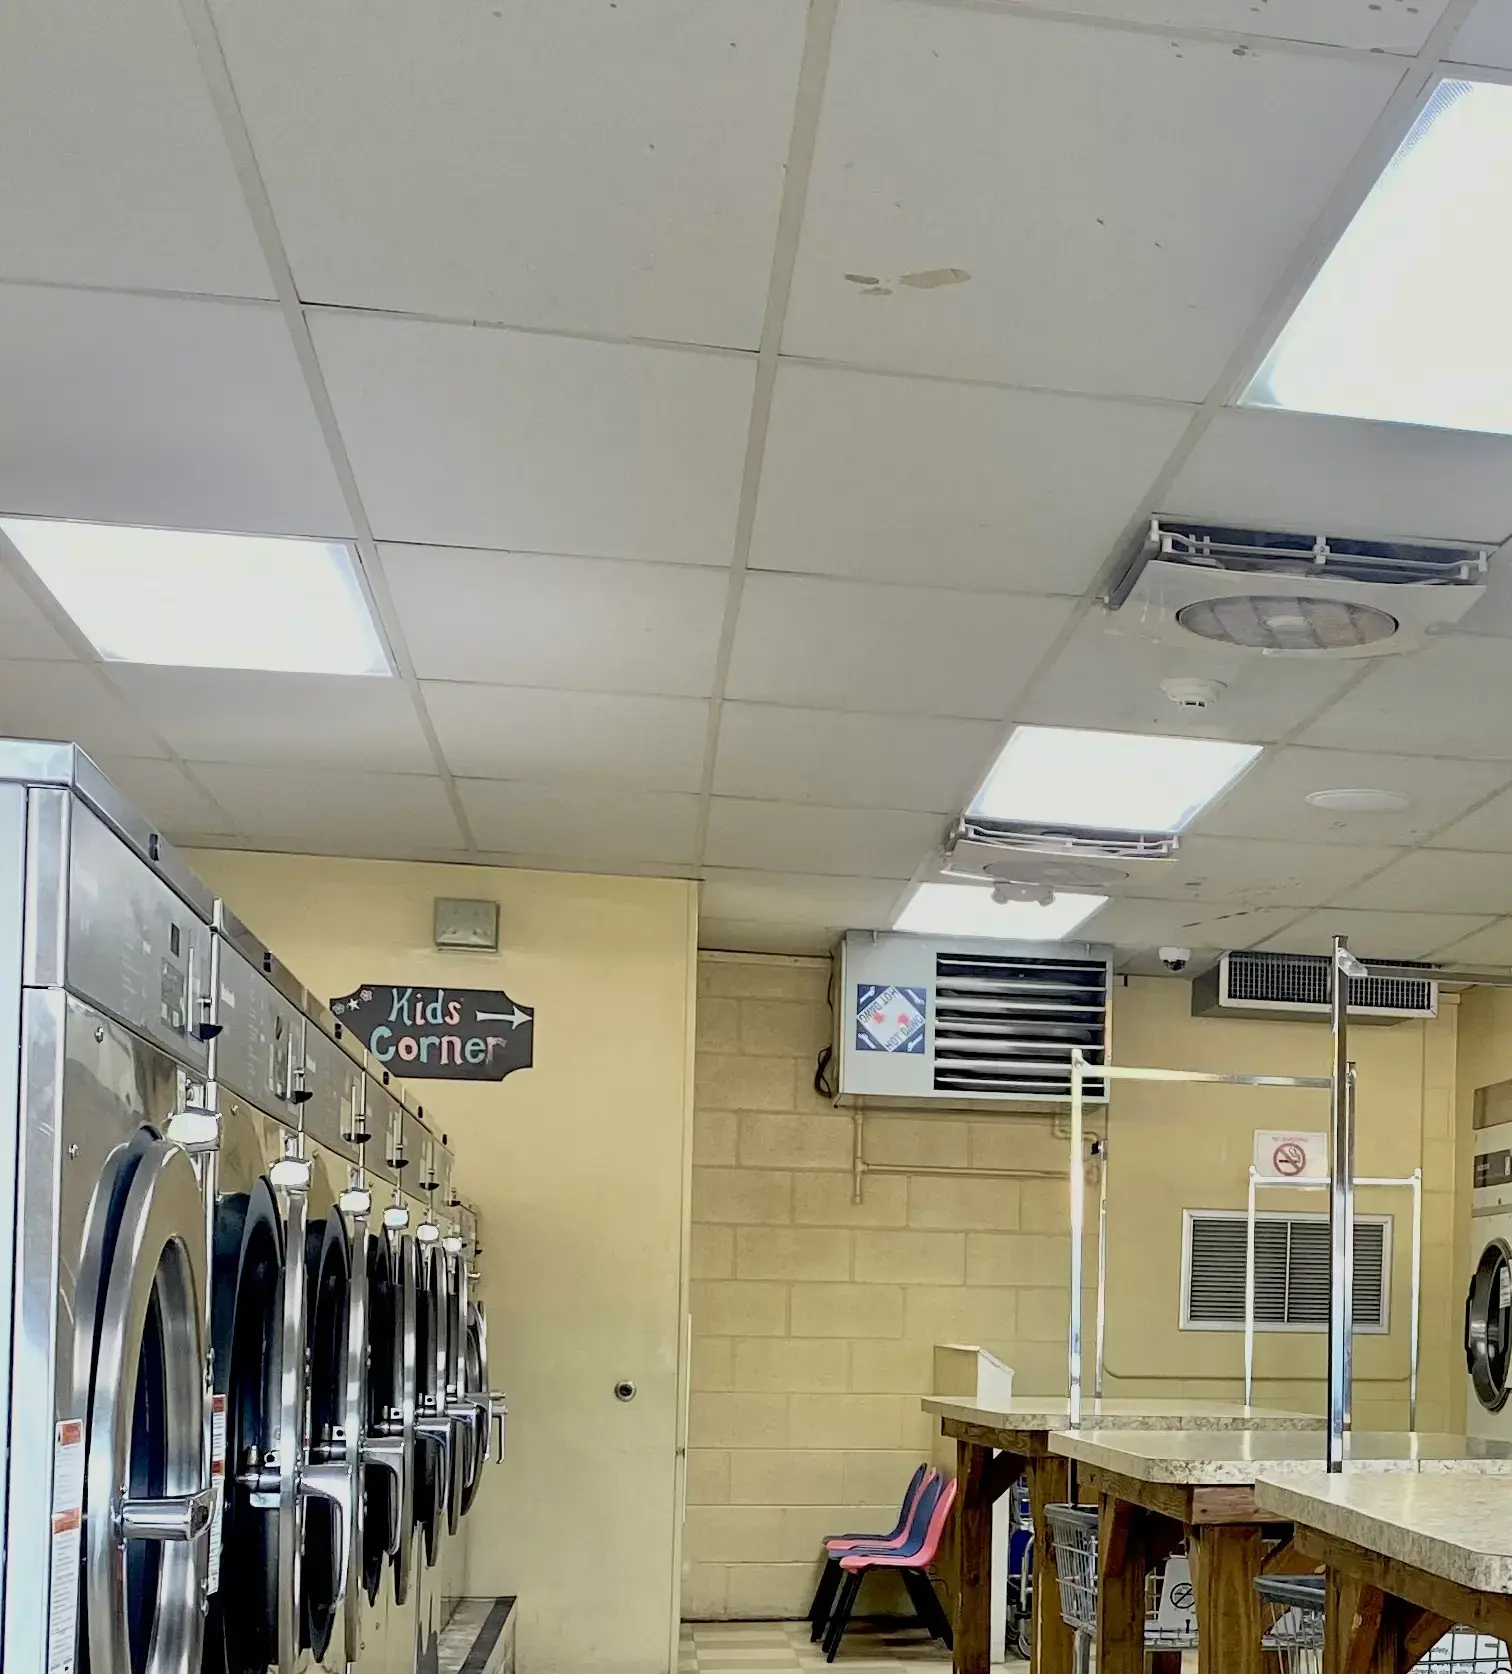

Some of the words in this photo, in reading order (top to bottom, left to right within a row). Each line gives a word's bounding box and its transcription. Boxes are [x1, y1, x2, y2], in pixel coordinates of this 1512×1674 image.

[387, 987, 462, 1027] Kids
[368, 1025, 508, 1066] Corner
[1430, 1647, 1451, 1656] afety.
